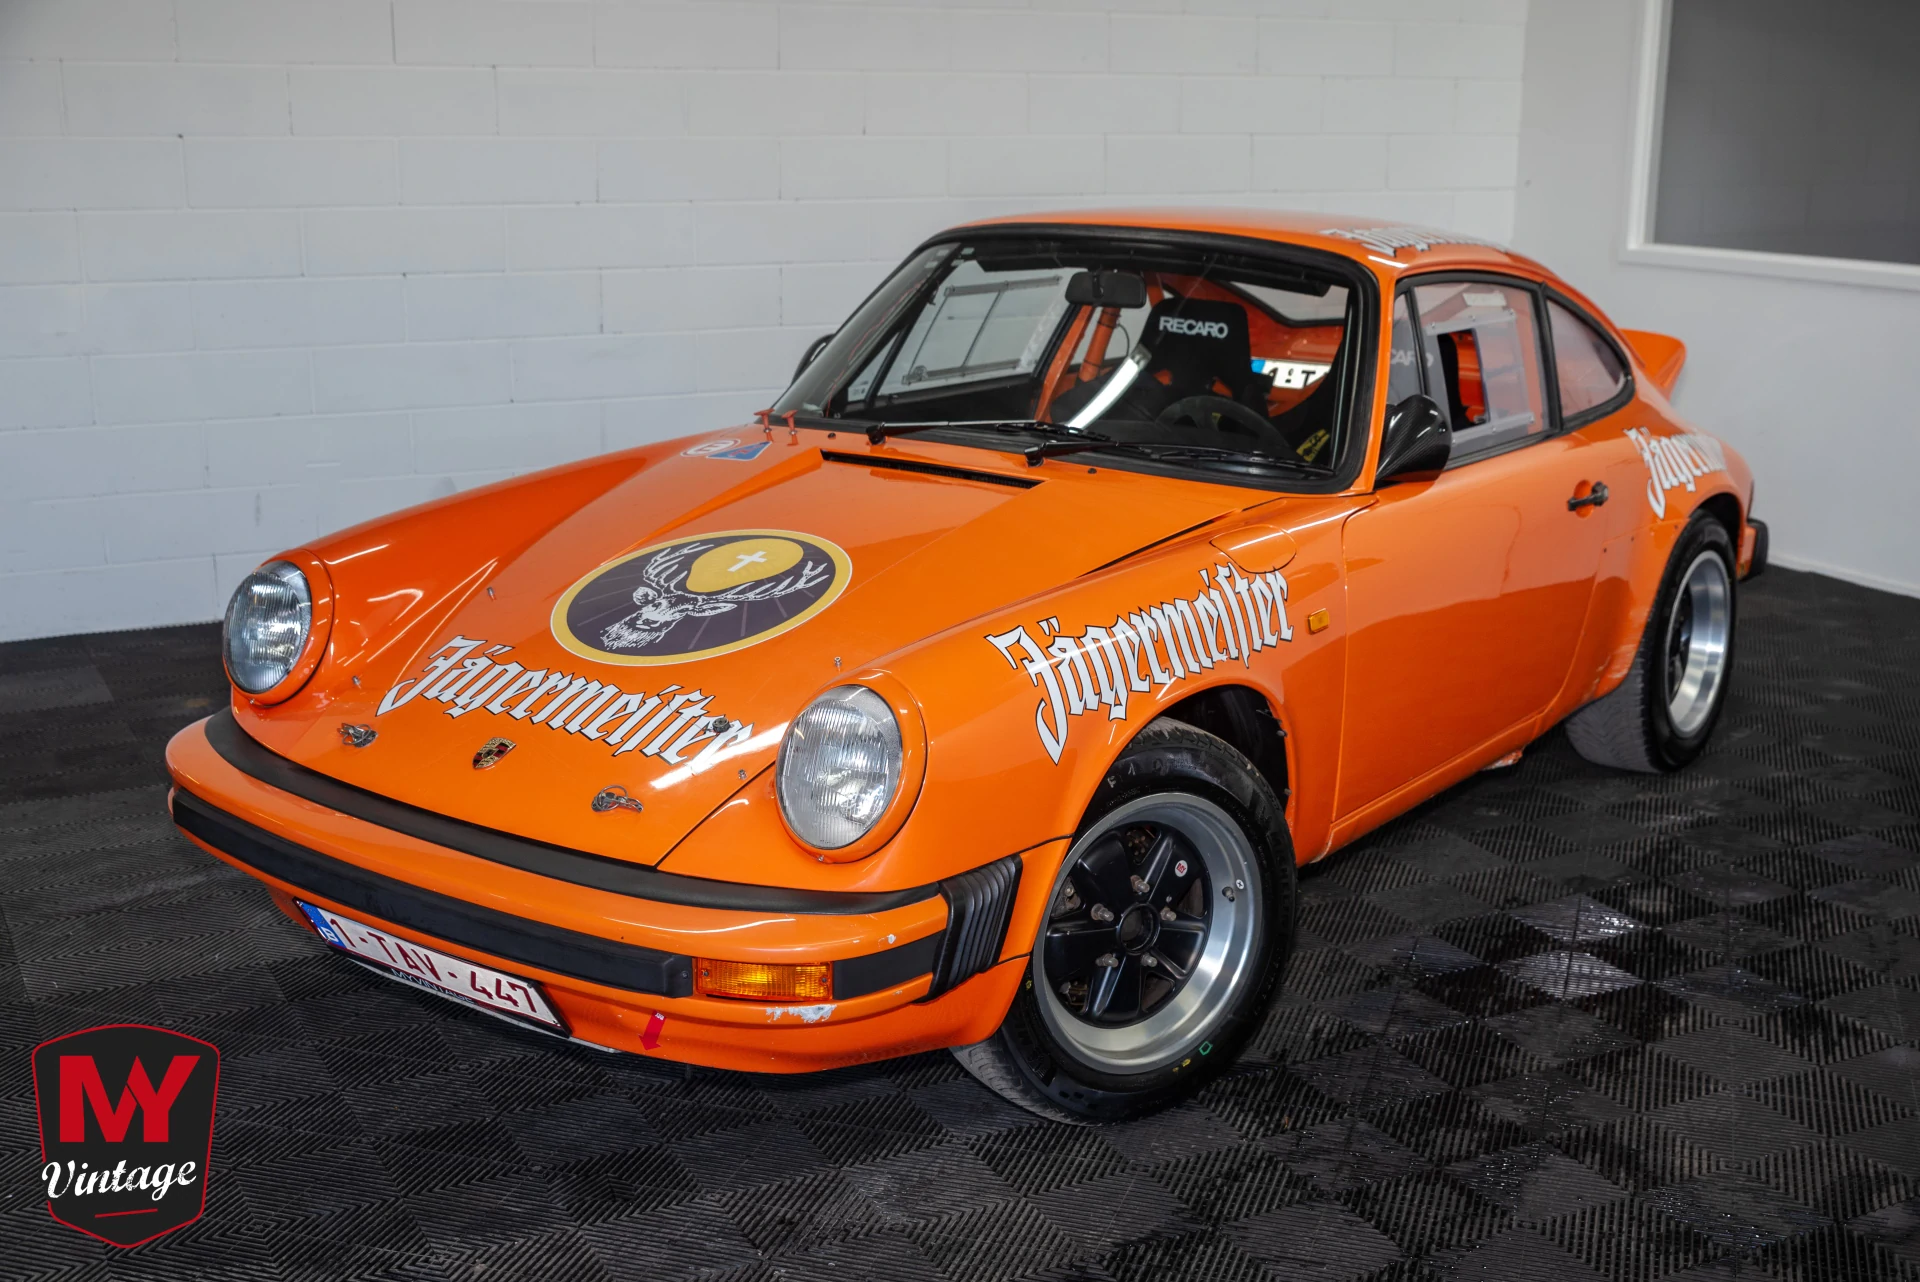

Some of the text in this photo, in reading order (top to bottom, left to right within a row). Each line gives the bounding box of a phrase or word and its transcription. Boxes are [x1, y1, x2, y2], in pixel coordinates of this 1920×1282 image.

[1159, 316, 1228, 338] RECARO
[376, 635, 754, 775] Jägermeister
[985, 562, 1293, 765] Jägermeister
